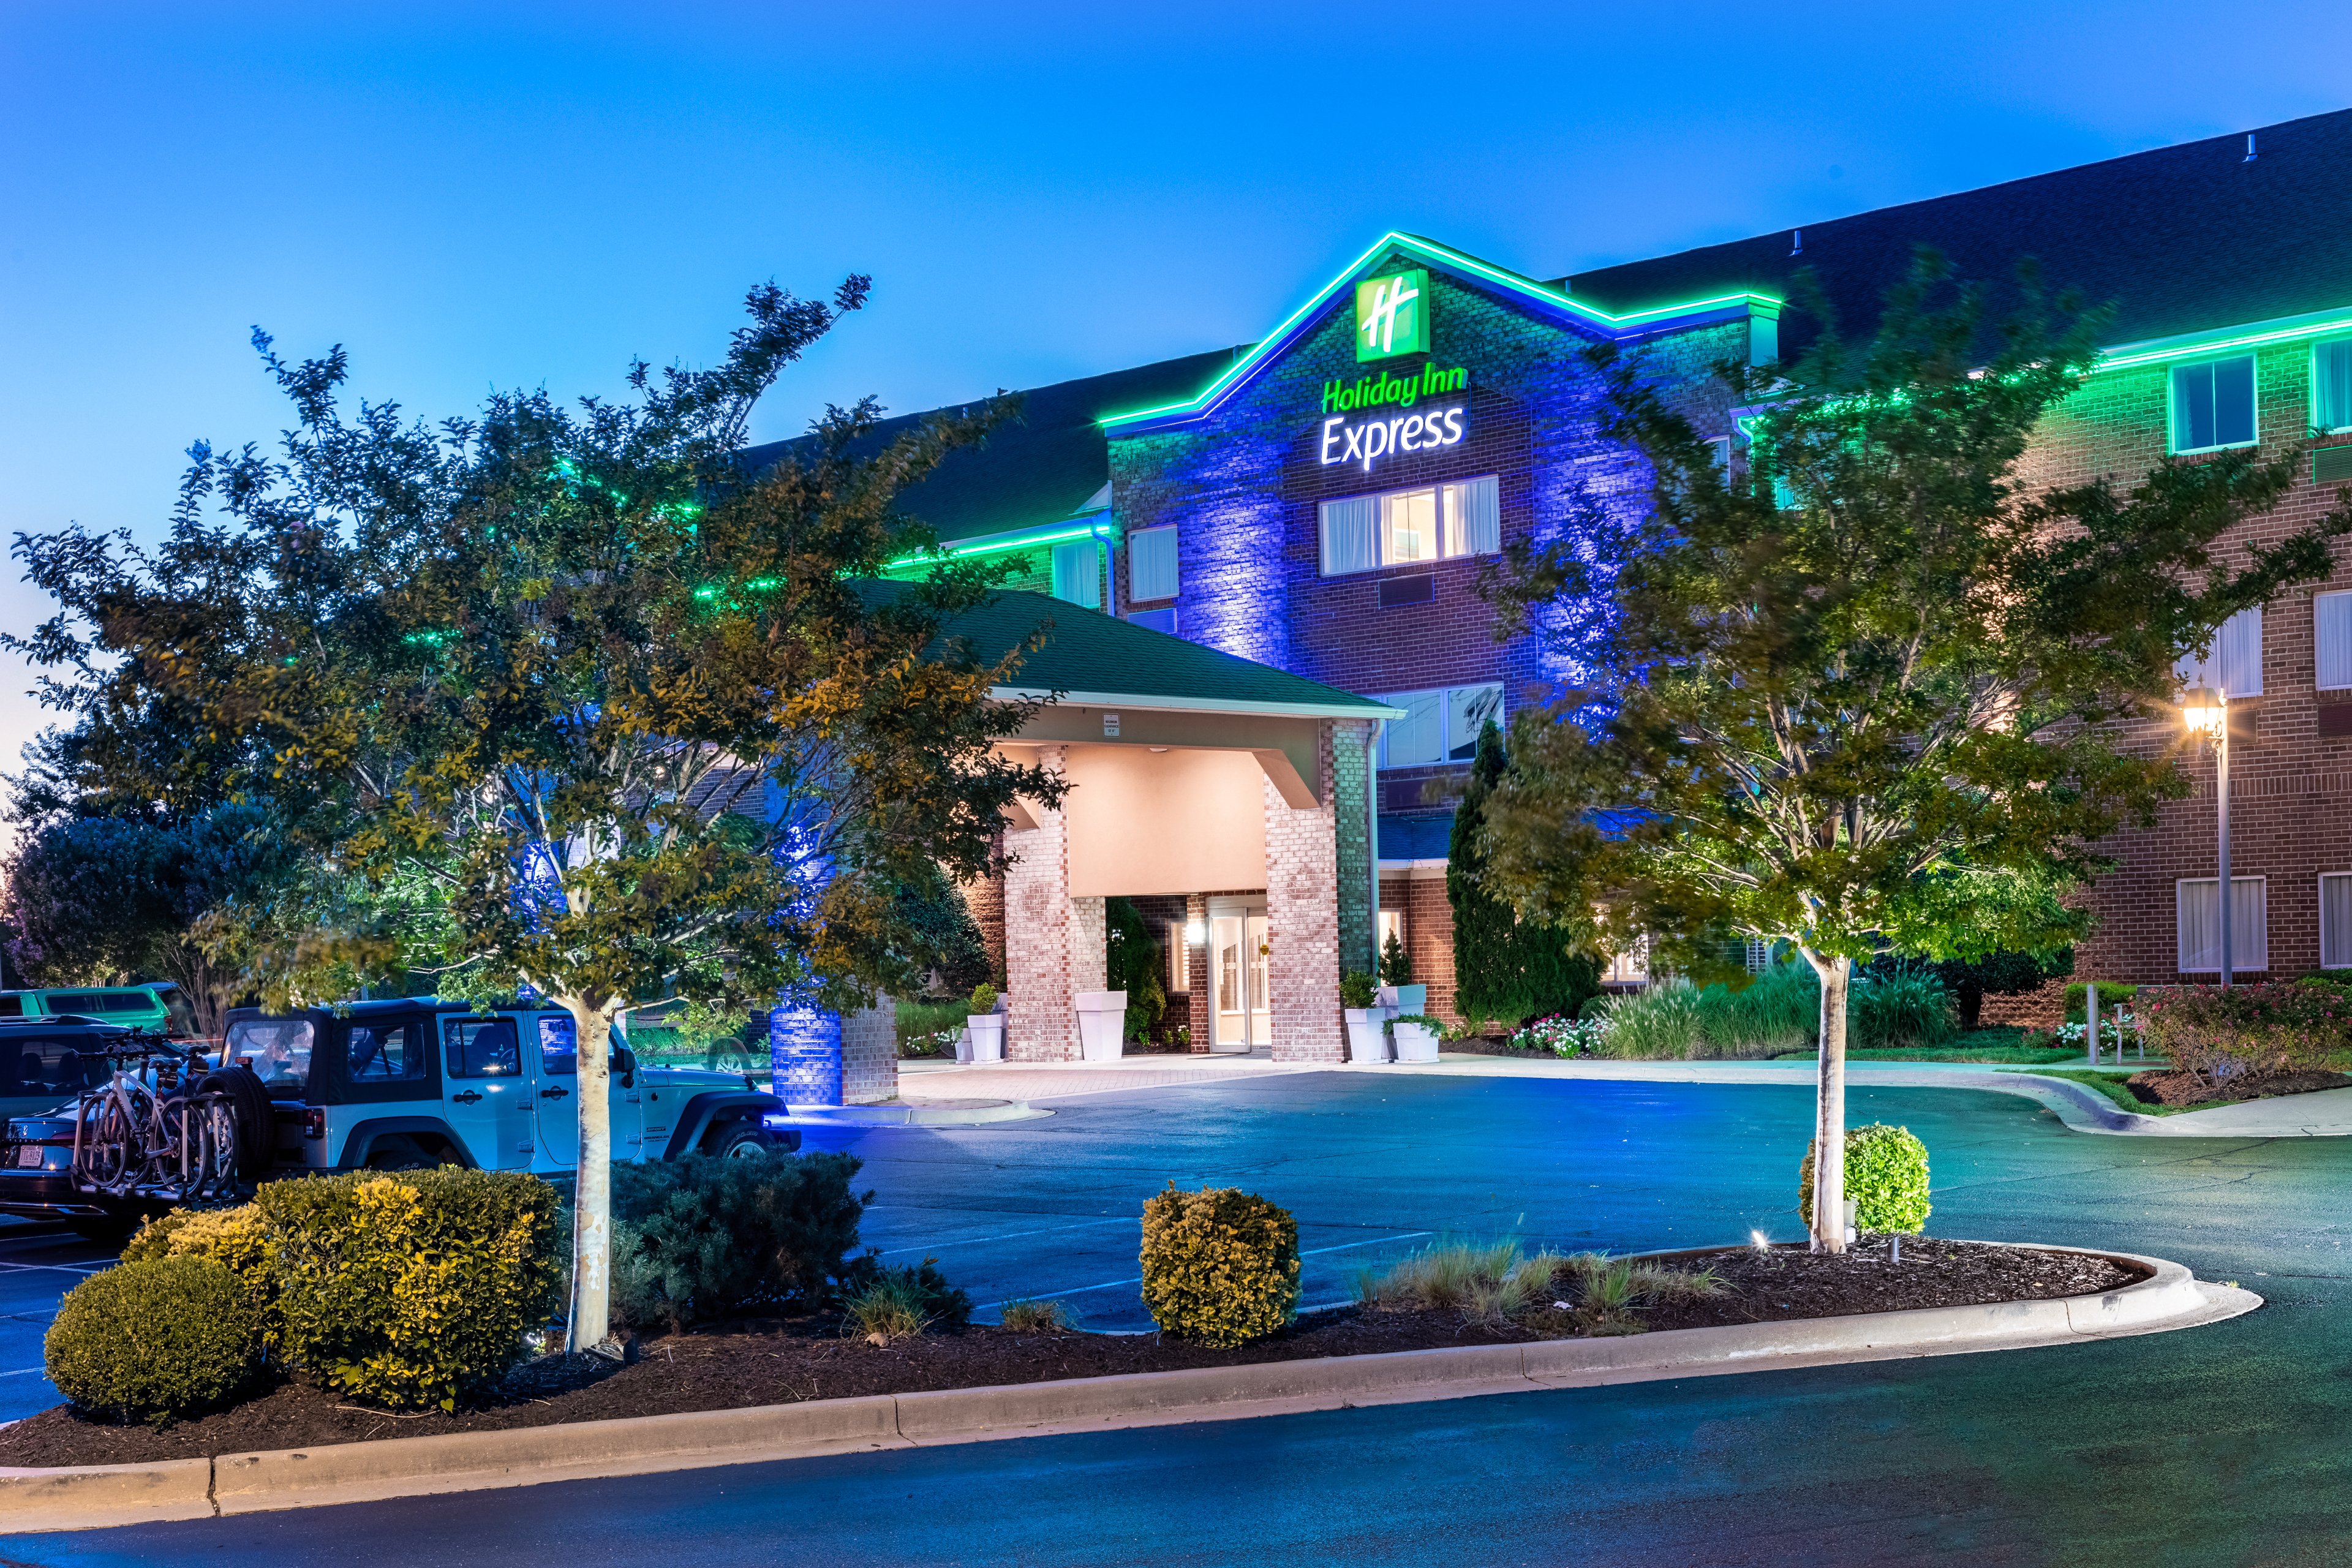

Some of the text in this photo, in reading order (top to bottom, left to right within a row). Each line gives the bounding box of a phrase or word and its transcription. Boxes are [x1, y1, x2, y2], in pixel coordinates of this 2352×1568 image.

[1321, 362, 1468, 414] Holiday Inn
[1320, 407, 1464, 472] Express
